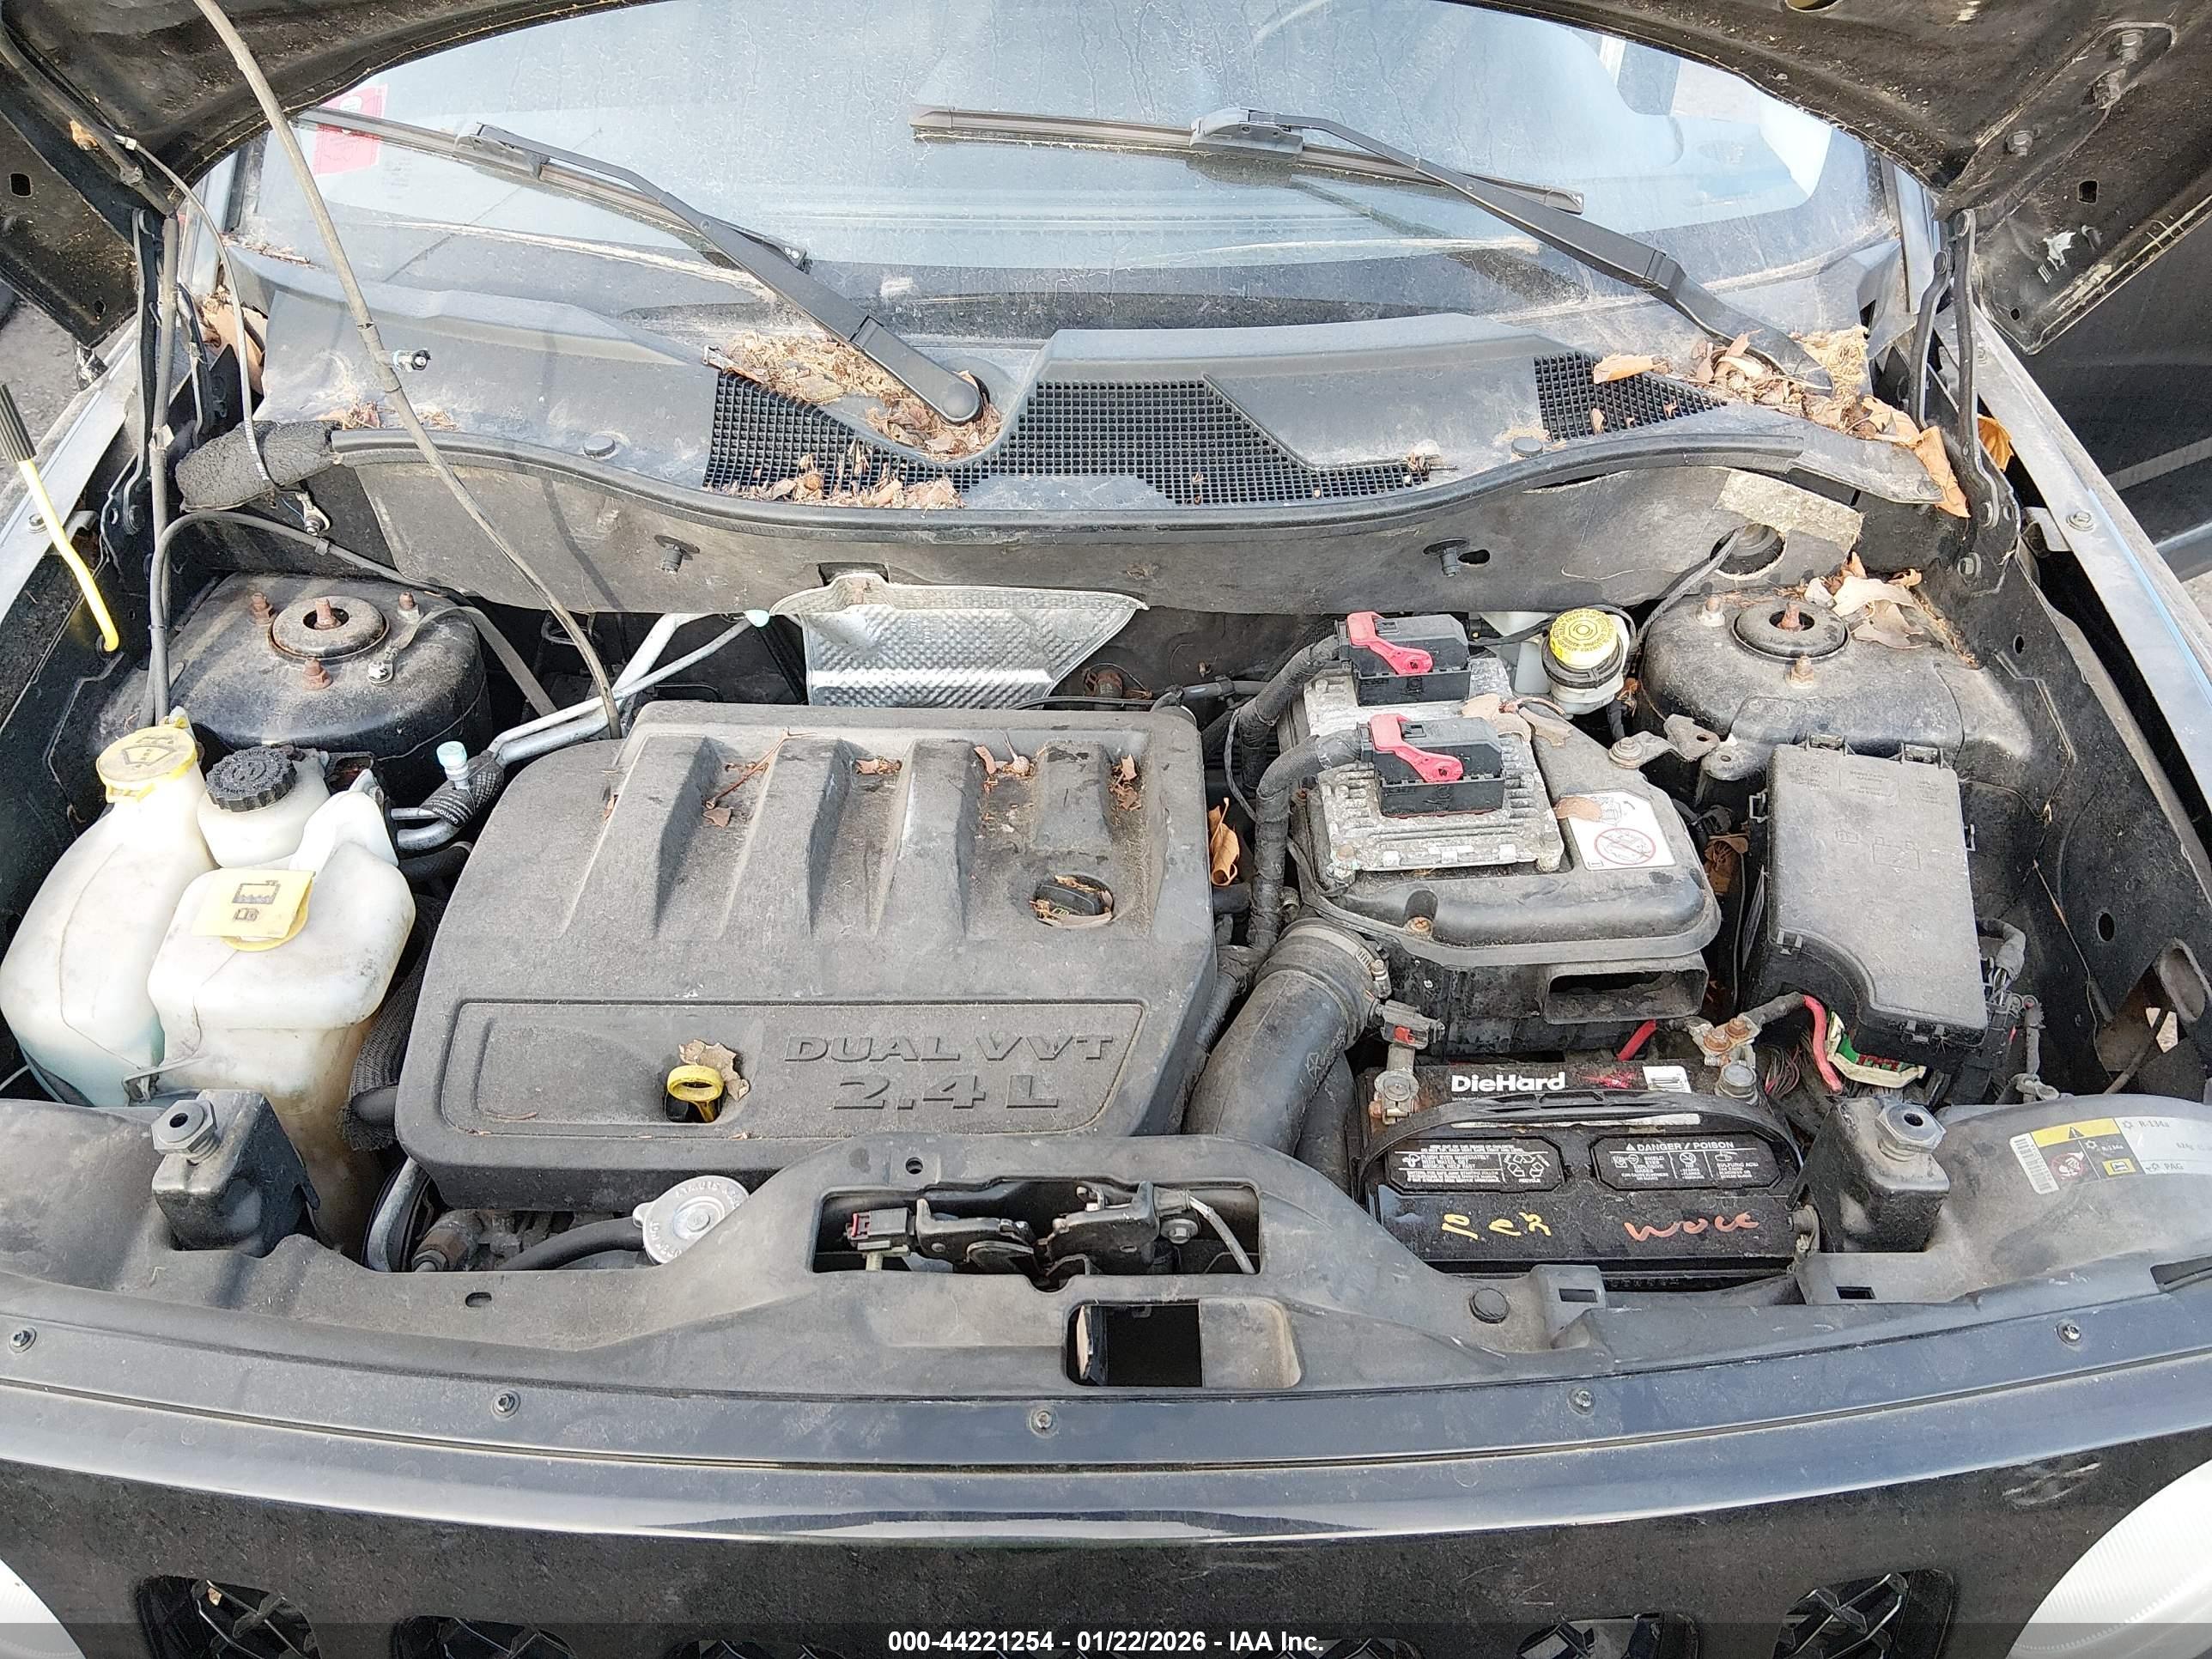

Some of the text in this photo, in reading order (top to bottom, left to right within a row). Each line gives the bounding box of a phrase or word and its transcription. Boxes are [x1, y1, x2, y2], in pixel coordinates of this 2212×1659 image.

[785, 1036, 1114, 1062] DUAL VVT
[833, 1074, 1059, 1110] 2.4 L
[1451, 1072, 1565, 1091] DieHard
